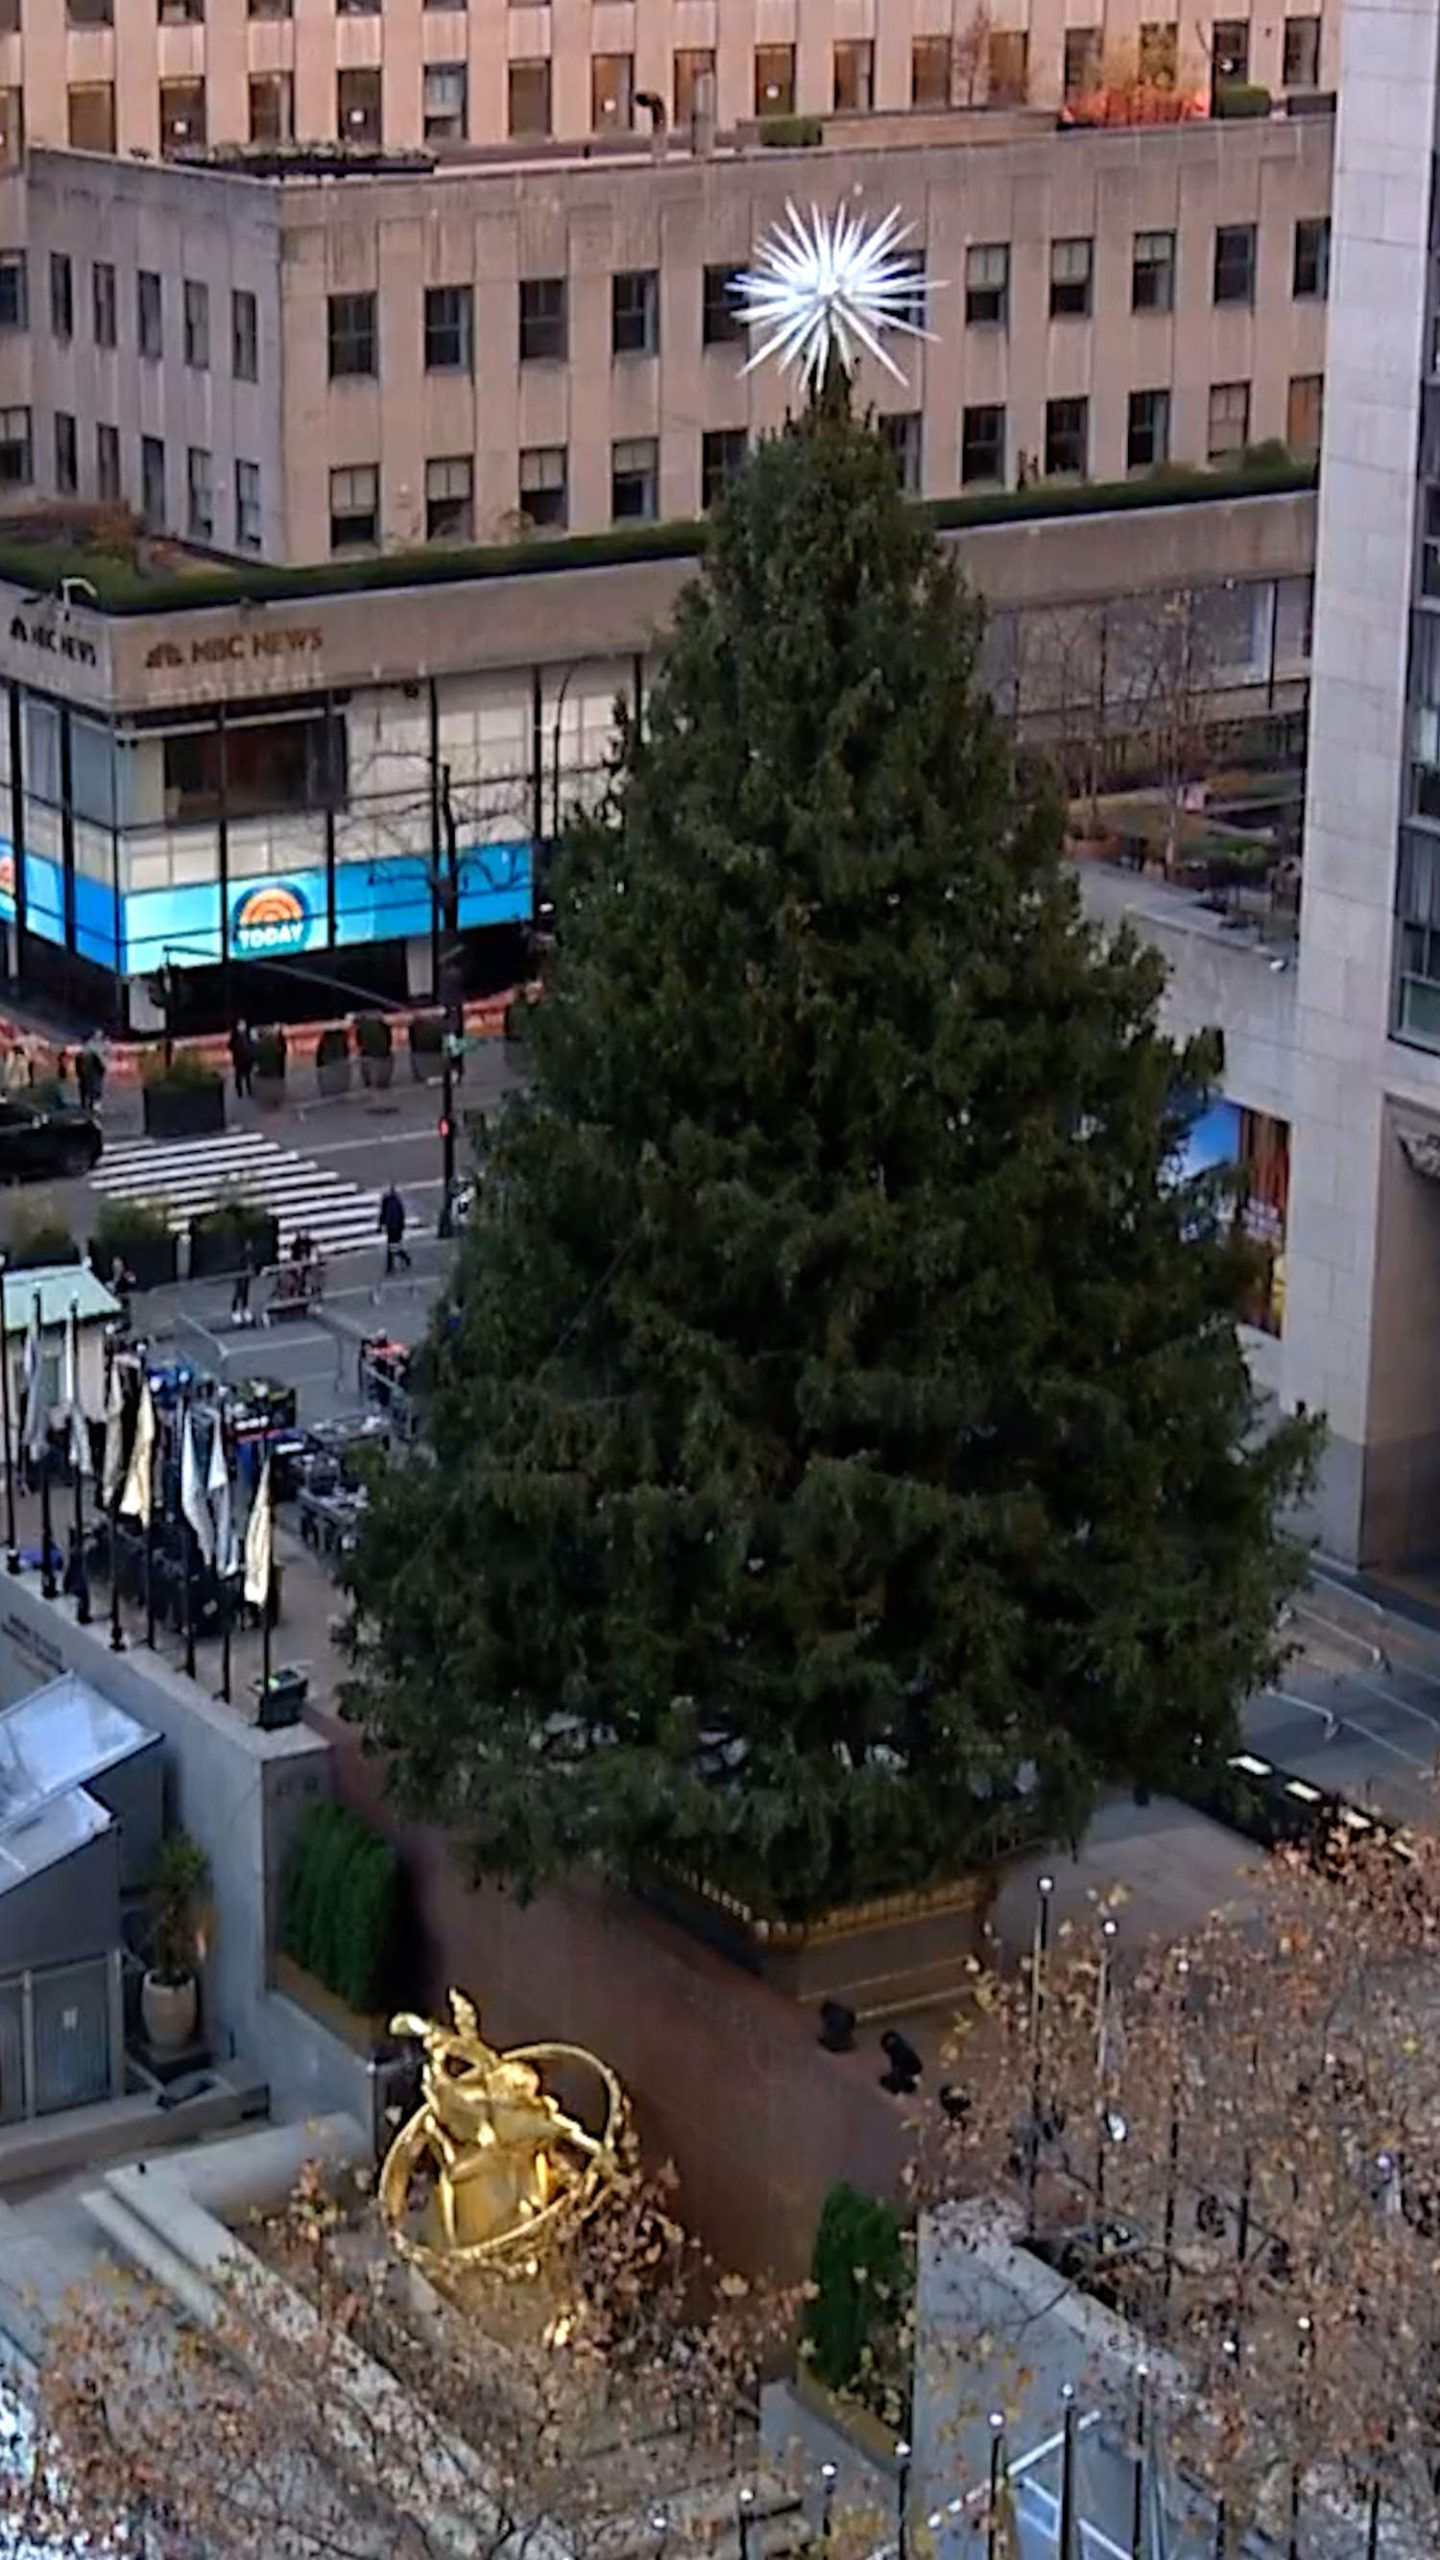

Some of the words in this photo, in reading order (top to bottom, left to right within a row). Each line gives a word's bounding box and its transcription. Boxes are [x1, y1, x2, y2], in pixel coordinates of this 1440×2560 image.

[191, 634, 244, 664] NBC
[252, 626, 323, 657] NEWS
[238, 921, 303, 949] TODAY
